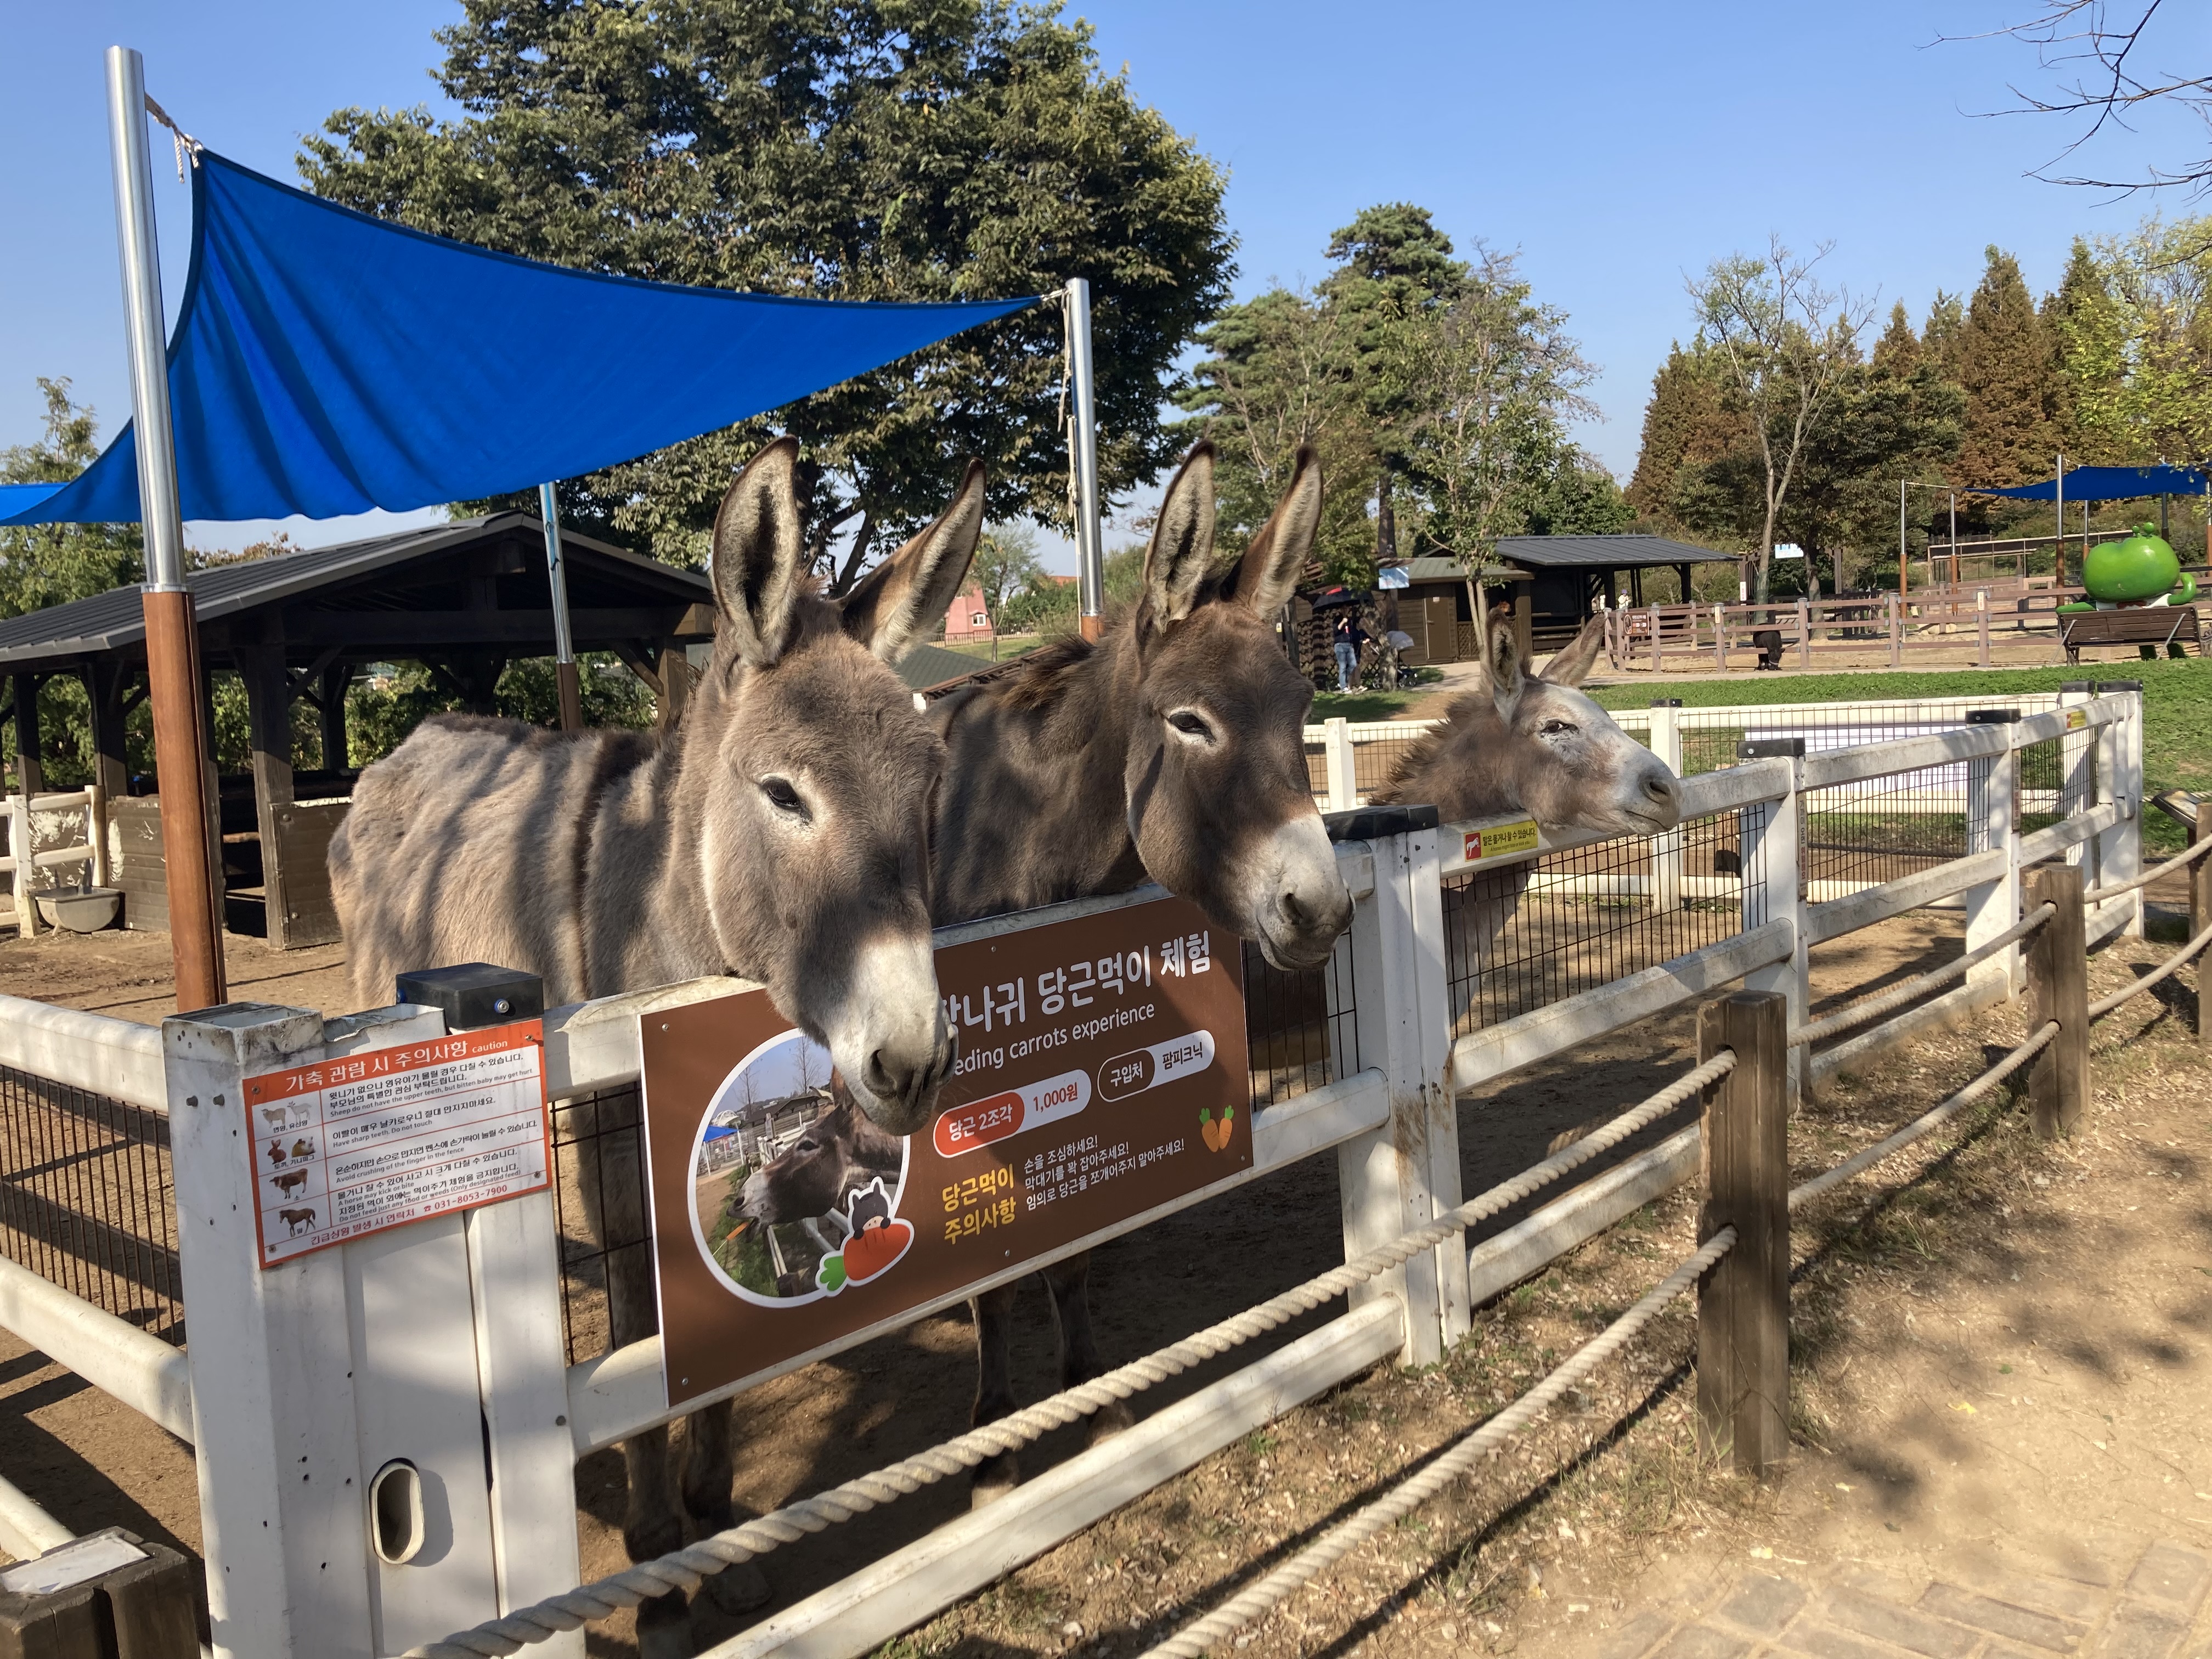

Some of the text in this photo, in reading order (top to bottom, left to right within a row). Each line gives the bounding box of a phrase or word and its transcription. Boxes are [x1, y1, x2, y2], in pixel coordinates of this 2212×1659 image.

[1483, 836, 1492, 846] 말은
[1493, 832, 1506, 844] 물거나
[1513, 831, 1517, 840] 수
[1037, 945, 1152, 1015] 당근먹이
[1160, 930, 1210, 978] 체험
[472, 1041, 507, 1053] caution
[955, 1003, 1155, 1075] eding carrots experience
[1162, 1042, 1203, 1070] 팜피크닉
[286, 1041, 467, 1092] 가축 관람 시 주의사항
[329, 1087, 355, 1101] 윗니가
[358, 1081, 383, 1094] 없으나
[386, 1074, 419, 1087] 영유아가
[441, 1066, 457, 1076] 경우
[460, 1063, 476, 1072] 다칠
[488, 1053, 523, 1066] 있습니다.
[1110, 1062, 1143, 1087] 구입처
[330, 1073, 466, 1109] 부모님의 특별한 관심 부탁드립니다.
[331, 1107, 351, 1117] Sheep
[404, 1092, 422, 1102] upper
[425, 1088, 443, 1096] teeth,
[457, 1080, 476, 1088] bitten
[508, 1071, 518, 1079] get
[1033, 1082, 1078, 1113] 1,000원
[332, 1127, 358, 1139] 이빨이
[361, 1122, 377, 1132] 매우
[425, 1108, 441, 1118] 절대
[444, 1097, 495, 1114] 만지지마세요.
[333, 1139, 349, 1148] Have
[351, 1134, 369, 1143] sharp
[414, 1120, 432, 1128] touch
[949, 1104, 1013, 1142] 당근 2조각
[336, 1159, 374, 1175] 온순하지만
[376, 1153, 399, 1165] 손으로
[401, 1146, 424, 1158] 만지면
[450, 1133, 479, 1146] 손가락이
[507, 1120, 537, 1133] 있습니다.
[1024, 1135, 1098, 1174] 손을 조심하세요!
[1025, 1141, 1129, 1191] 막대기를 꽉 잡아주세요!
[336, 1173, 355, 1183] Avoid
[357, 1166, 384, 1178] crushing
[407, 1156, 426, 1165] finger
[367, 1197, 383, 1206] 먹이
[386, 1190, 411, 1202] 외에는
[414, 1181, 447, 1194] 먹이주기
[449, 1173, 473, 1186] 체험을
[476, 1163, 518, 1180] 금지합니다.
[387, 1176, 403, 1187] 있어
[406, 1171, 422, 1180] 사고
[425, 1168, 433, 1177] 시
[436, 1164, 452, 1174] 크게
[454, 1159, 470, 1169] 다칠
[483, 1148, 517, 1162] 있습니다.
[1026, 1138, 1184, 1211] 임의로 당근을 쪼개어주지 말아주세요!
[345, 1196, 363, 1205] horse
[363, 1207, 376, 1215] feed
[378, 1204, 391, 1212] just
[430, 1187, 449, 1197] weeds
[451, 1183, 467, 1193] (Only
[469, 1174, 504, 1187] designated
[505, 1169, 521, 1178] feed)
[435, 1184, 507, 1210] 031-8053-7900
[942, 1163, 1014, 1213] 당근먹이
[311, 1209, 415, 1246] 긴급상황 발생 시 연락처
[944, 1197, 1017, 1245] 주의사항
